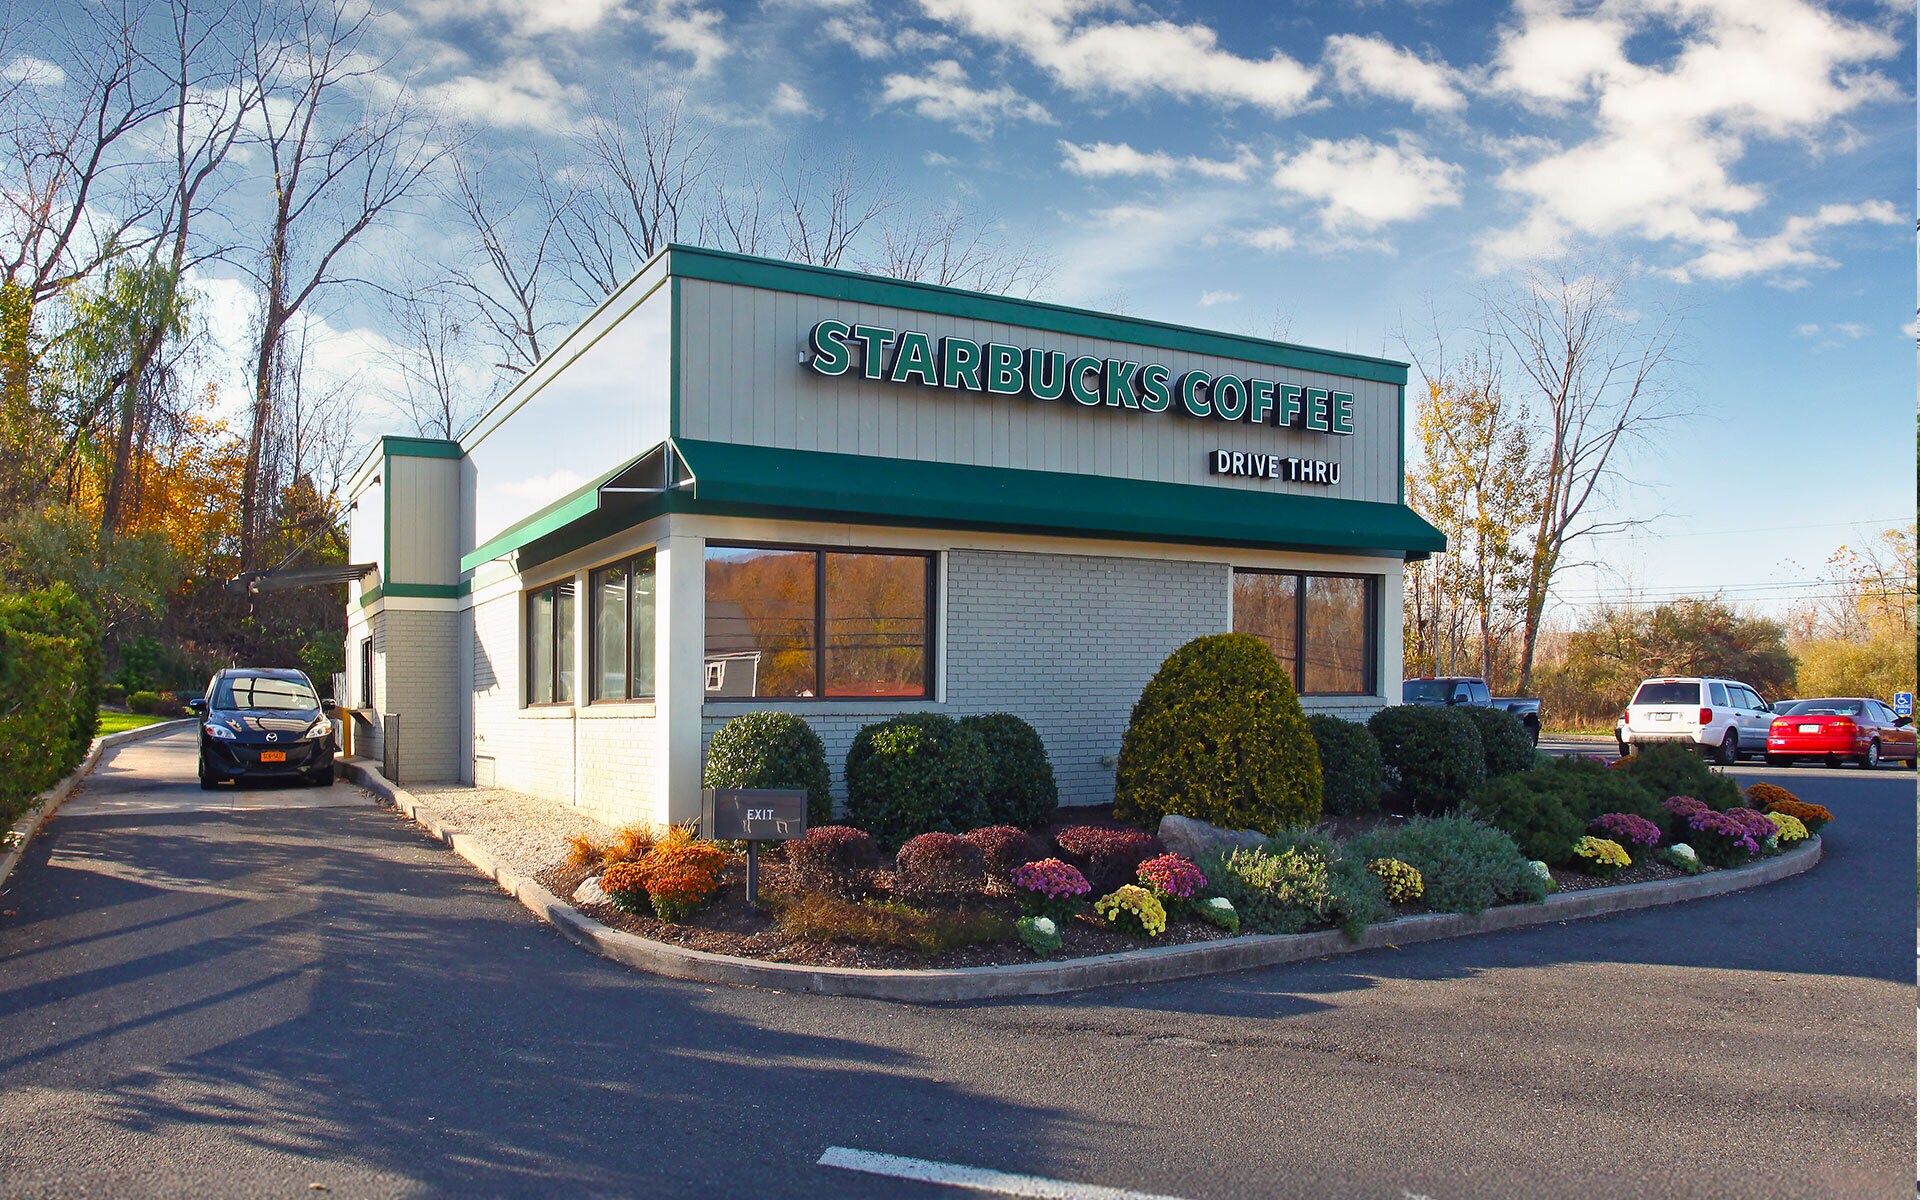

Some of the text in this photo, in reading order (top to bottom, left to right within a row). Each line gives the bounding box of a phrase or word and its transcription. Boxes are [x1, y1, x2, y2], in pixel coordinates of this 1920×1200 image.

[810, 319, 1354, 435] STARBUCKS COFFEE
[1217, 449, 1341, 485] DRIVE THRU
[747, 809, 774, 820] EXIT
